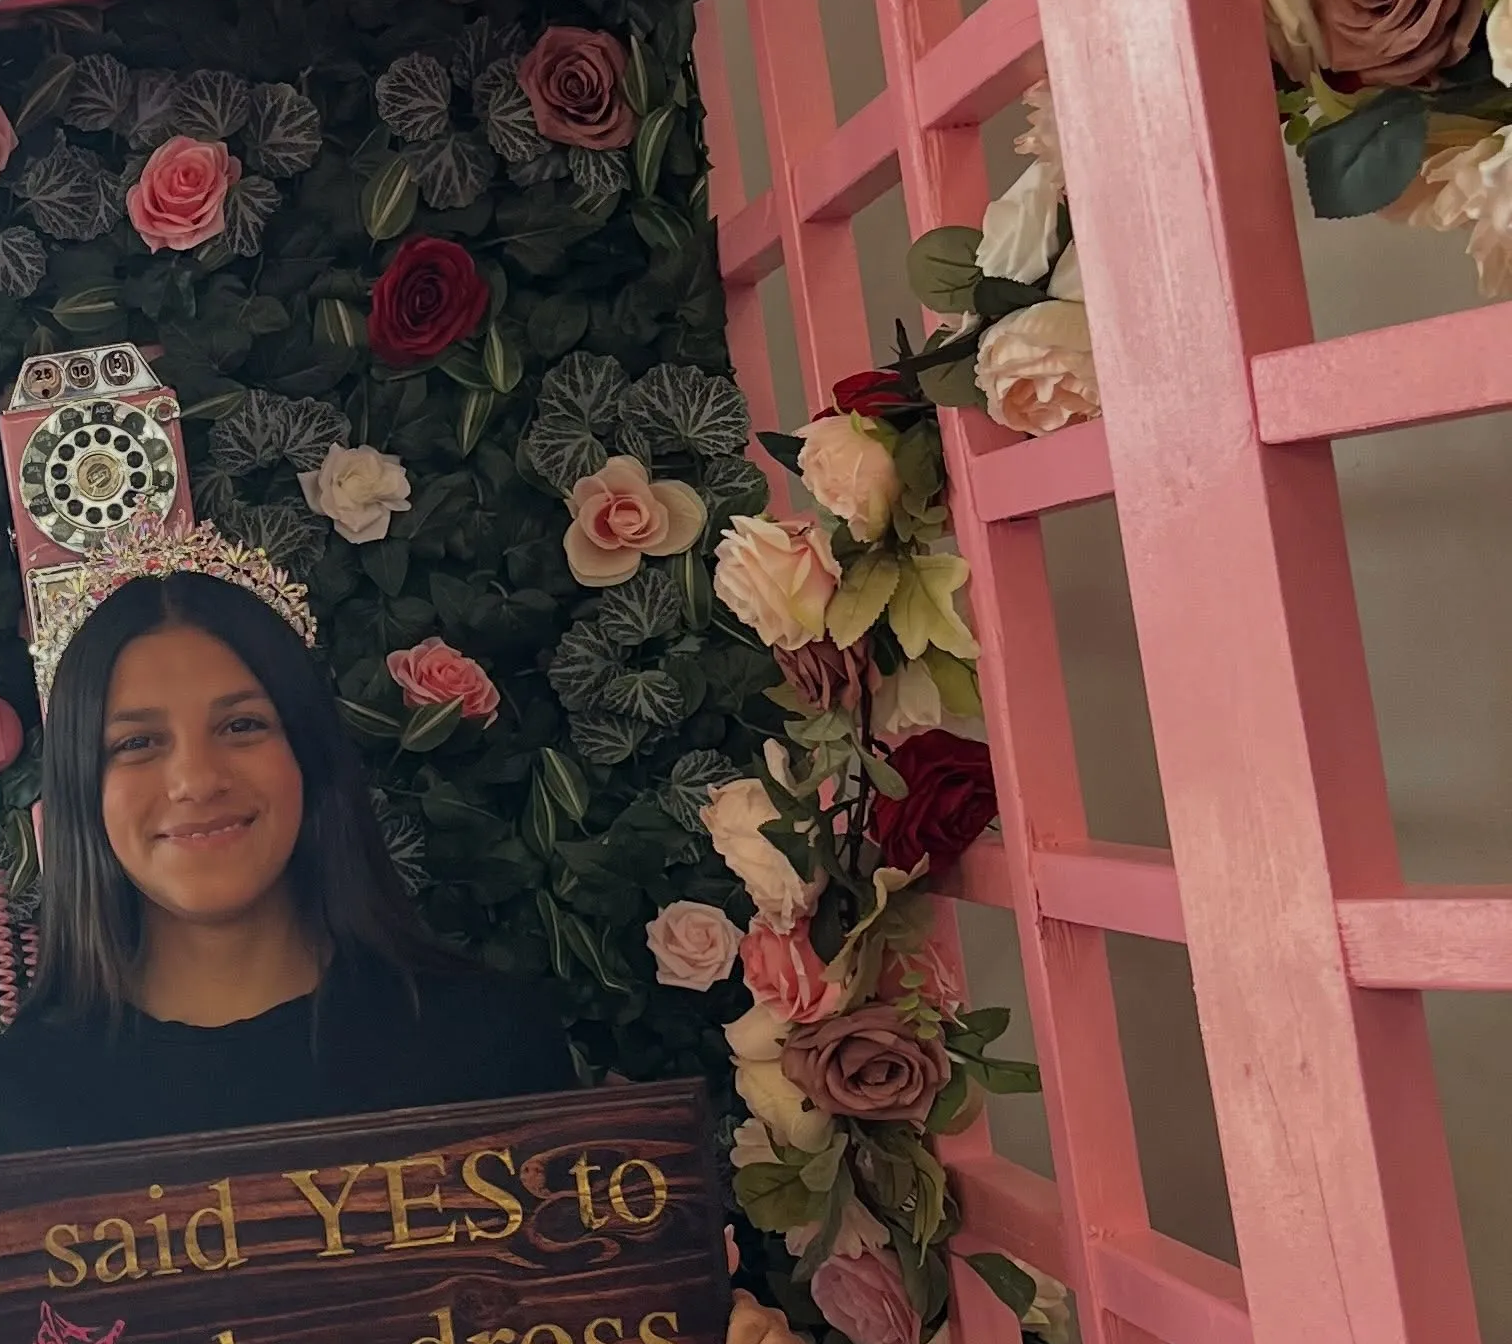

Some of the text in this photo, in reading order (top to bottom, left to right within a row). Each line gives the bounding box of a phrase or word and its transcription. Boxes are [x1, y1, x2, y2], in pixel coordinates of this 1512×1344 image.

[34, 368, 52, 380] 25
[72, 365, 90, 377] 10
[44, 1177, 249, 1291] said
[283, 1149, 524, 1257] YES
[569, 1151, 669, 1231] to
